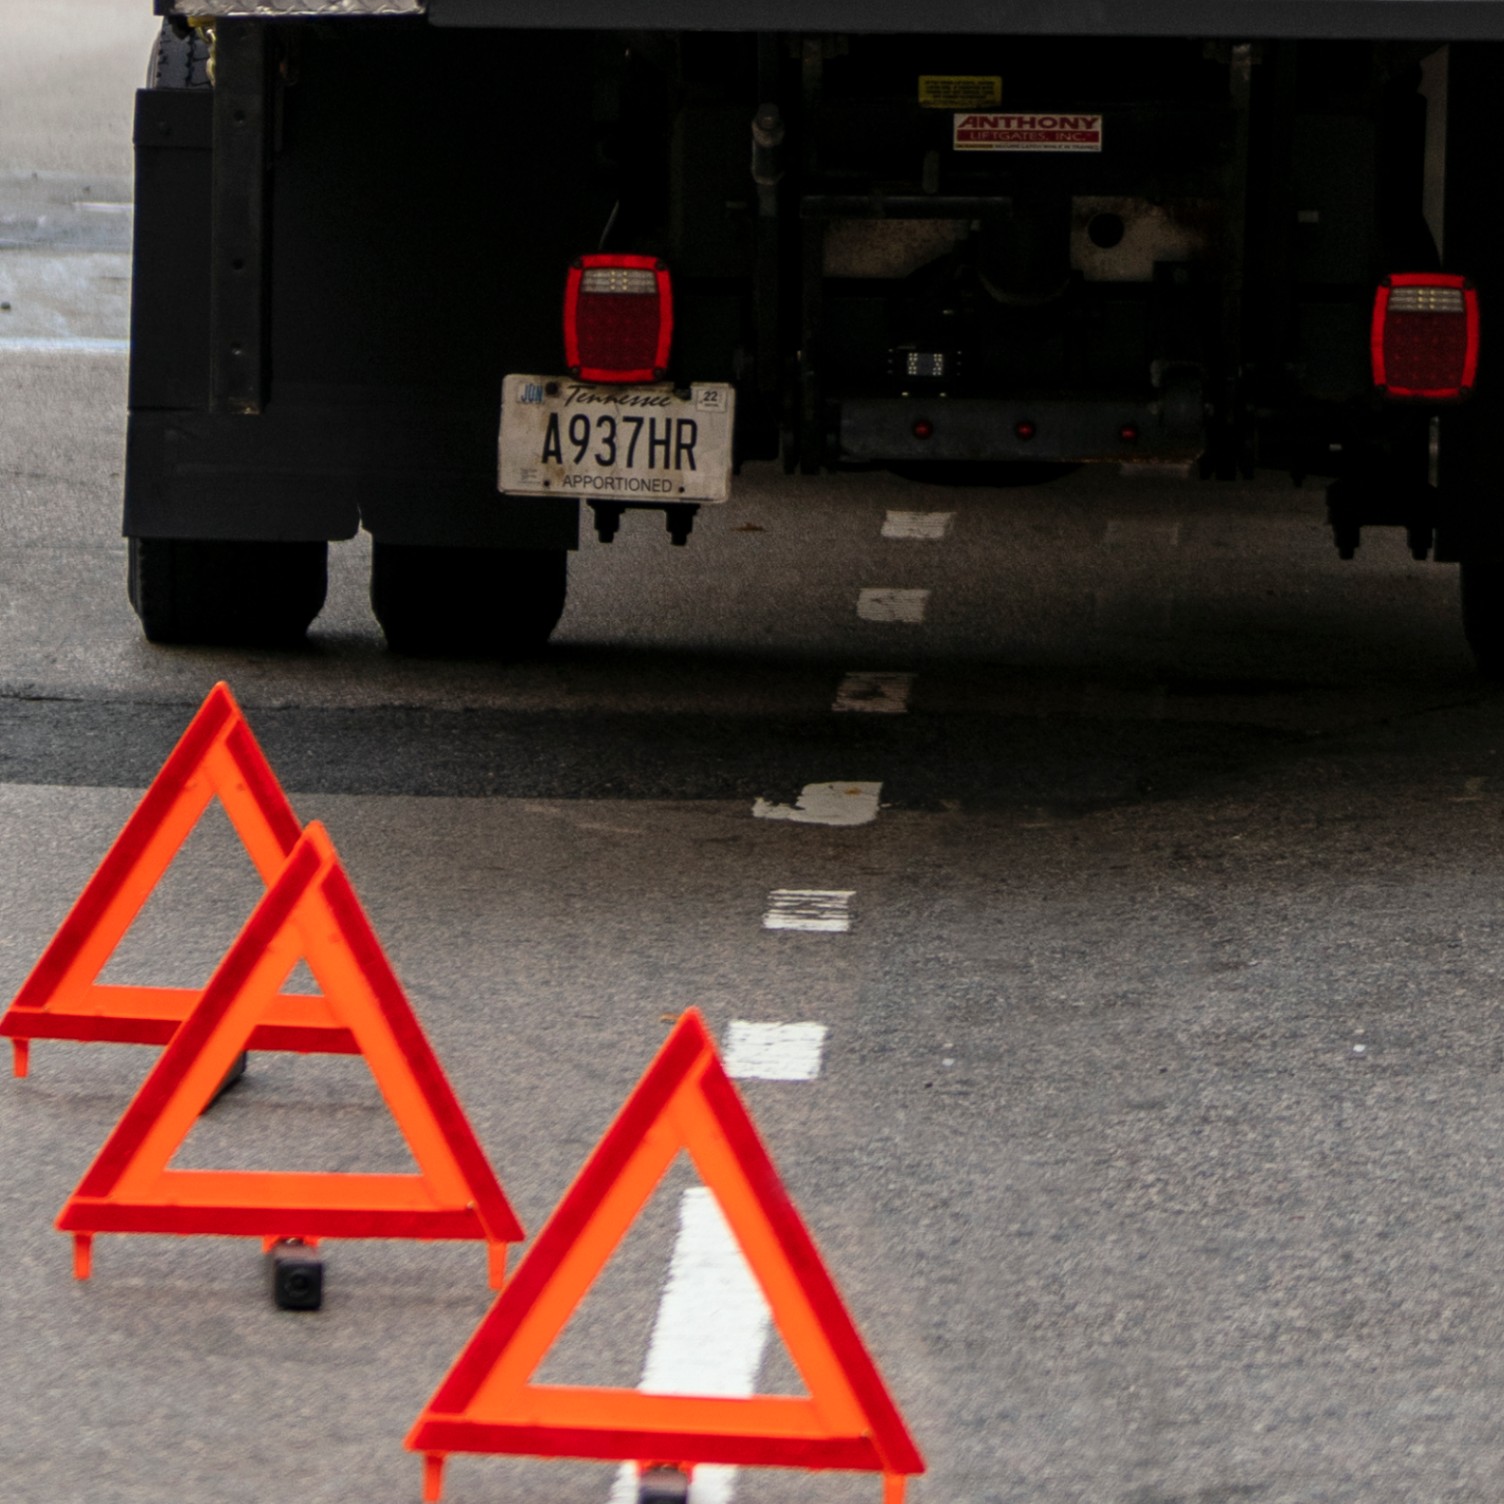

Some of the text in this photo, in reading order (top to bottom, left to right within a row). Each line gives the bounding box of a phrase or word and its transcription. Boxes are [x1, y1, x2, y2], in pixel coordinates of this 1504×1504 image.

[957, 115, 1099, 130] ANTHONY
[563, 384, 672, 408] Tennessee
[702, 391, 718, 403] 22
[541, 412, 698, 471] A937HR
[561, 474, 672, 493] APPORTIONED
